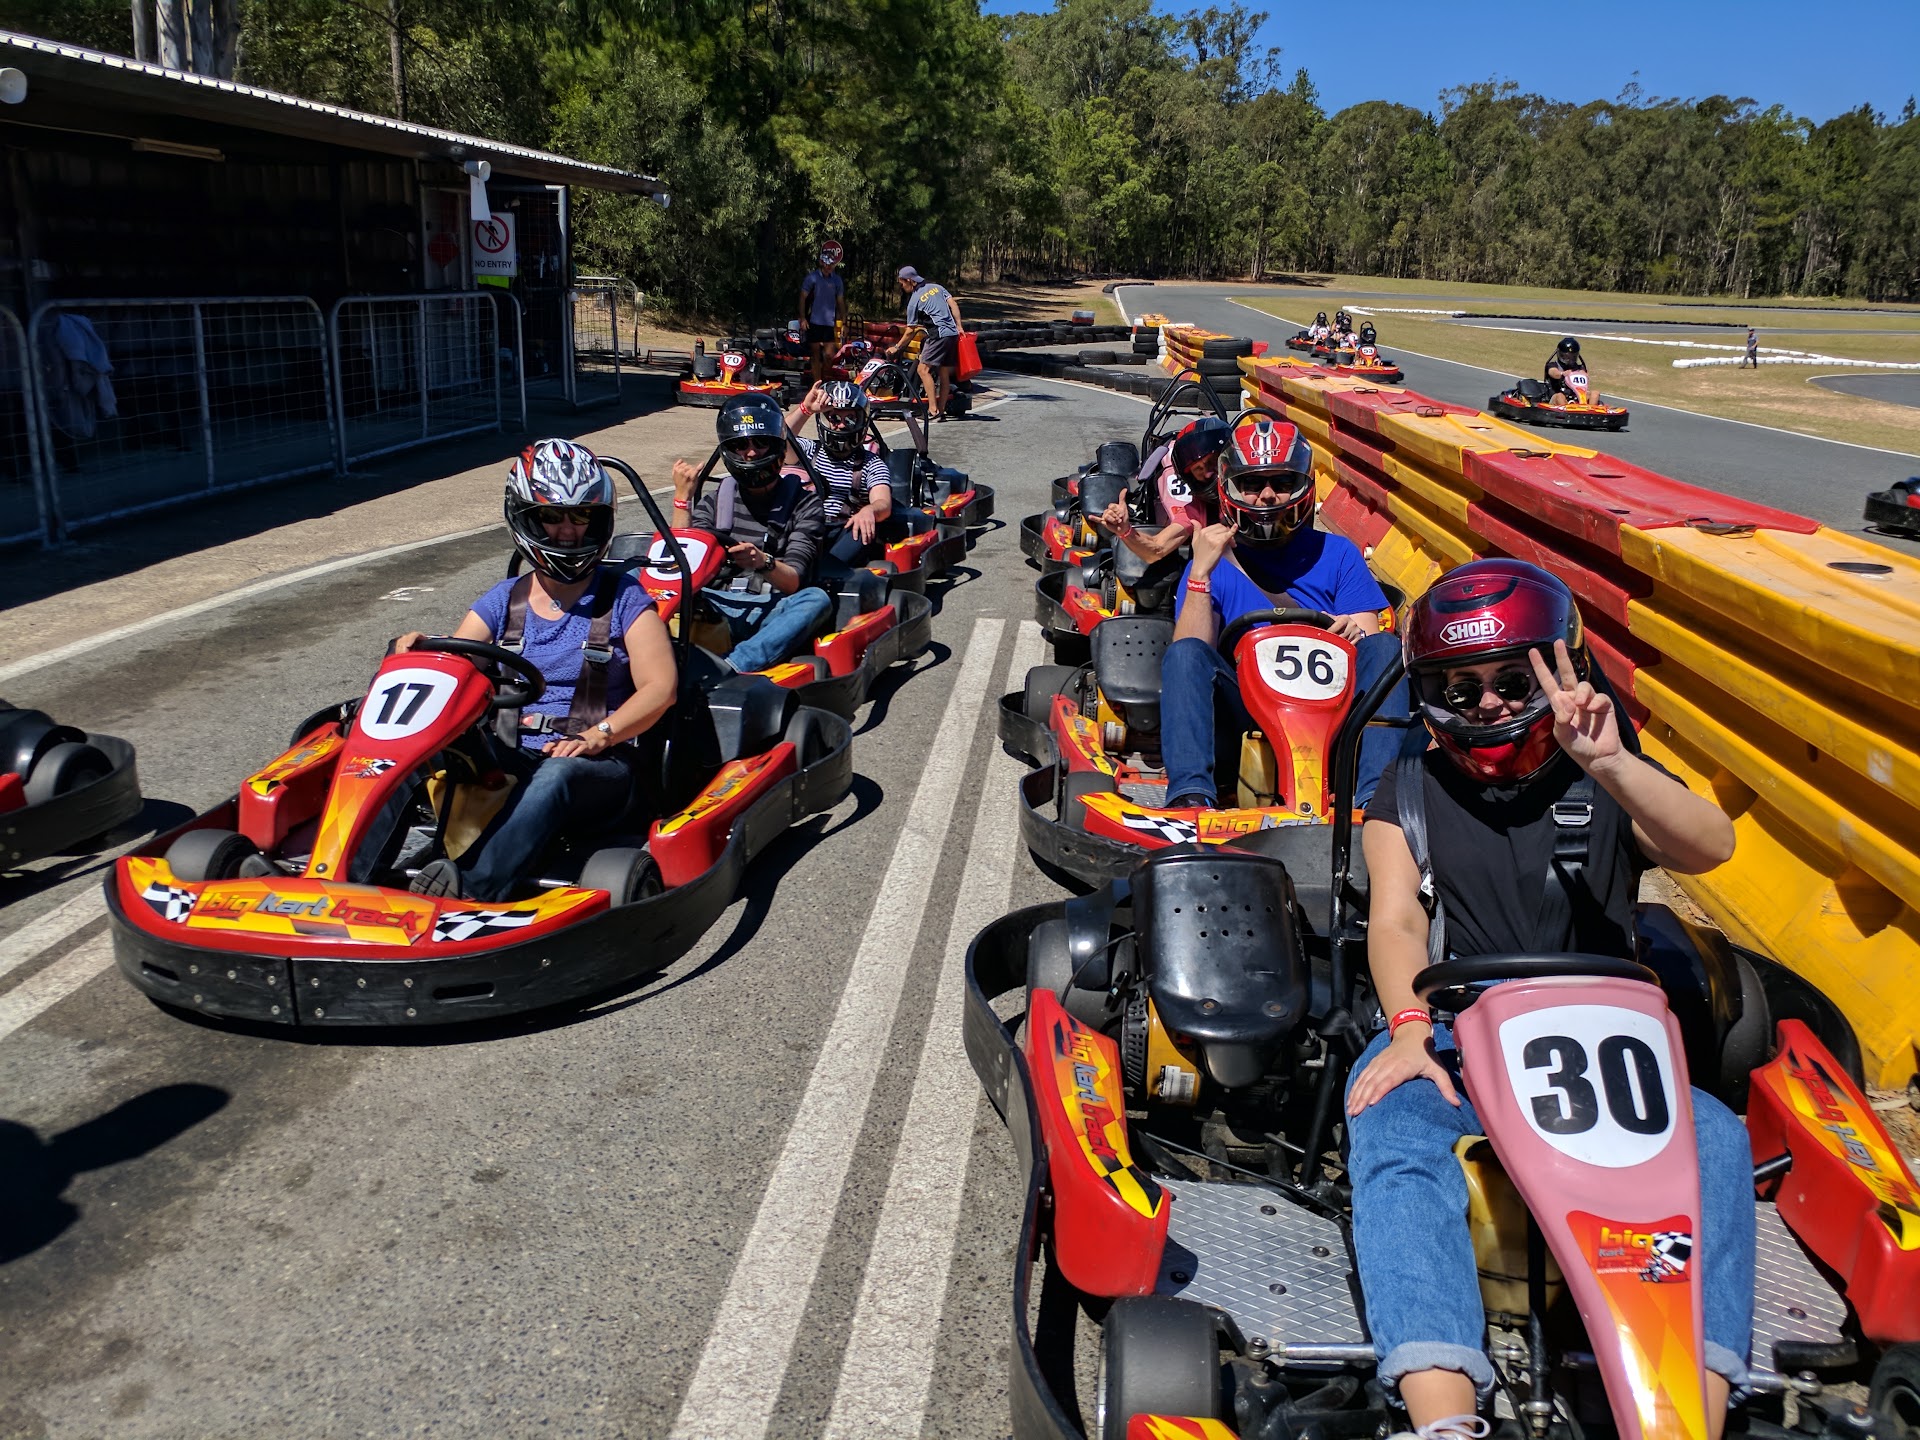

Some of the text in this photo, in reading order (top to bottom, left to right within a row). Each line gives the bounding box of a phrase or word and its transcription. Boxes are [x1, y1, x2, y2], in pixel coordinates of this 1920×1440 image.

[475, 260, 512, 269] NO ENTRY
[726, 356, 740, 364] 70
[864, 363, 877, 371] 37
[1572, 376, 1586, 384] 40
[733, 423, 765, 431] SONIC
[741, 415, 754, 424] XS
[1447, 617, 1495, 642] SHOEI
[1274, 645, 1334, 686] 56
[375, 682, 436, 726] 17
[1206, 817, 1257, 839] big
[200, 892, 257, 919] big
[329, 899, 425, 931] track
[1062, 1030, 1094, 1062] big
[1523, 1035, 1669, 1135] 30
[1601, 1227, 1654, 1253] big
